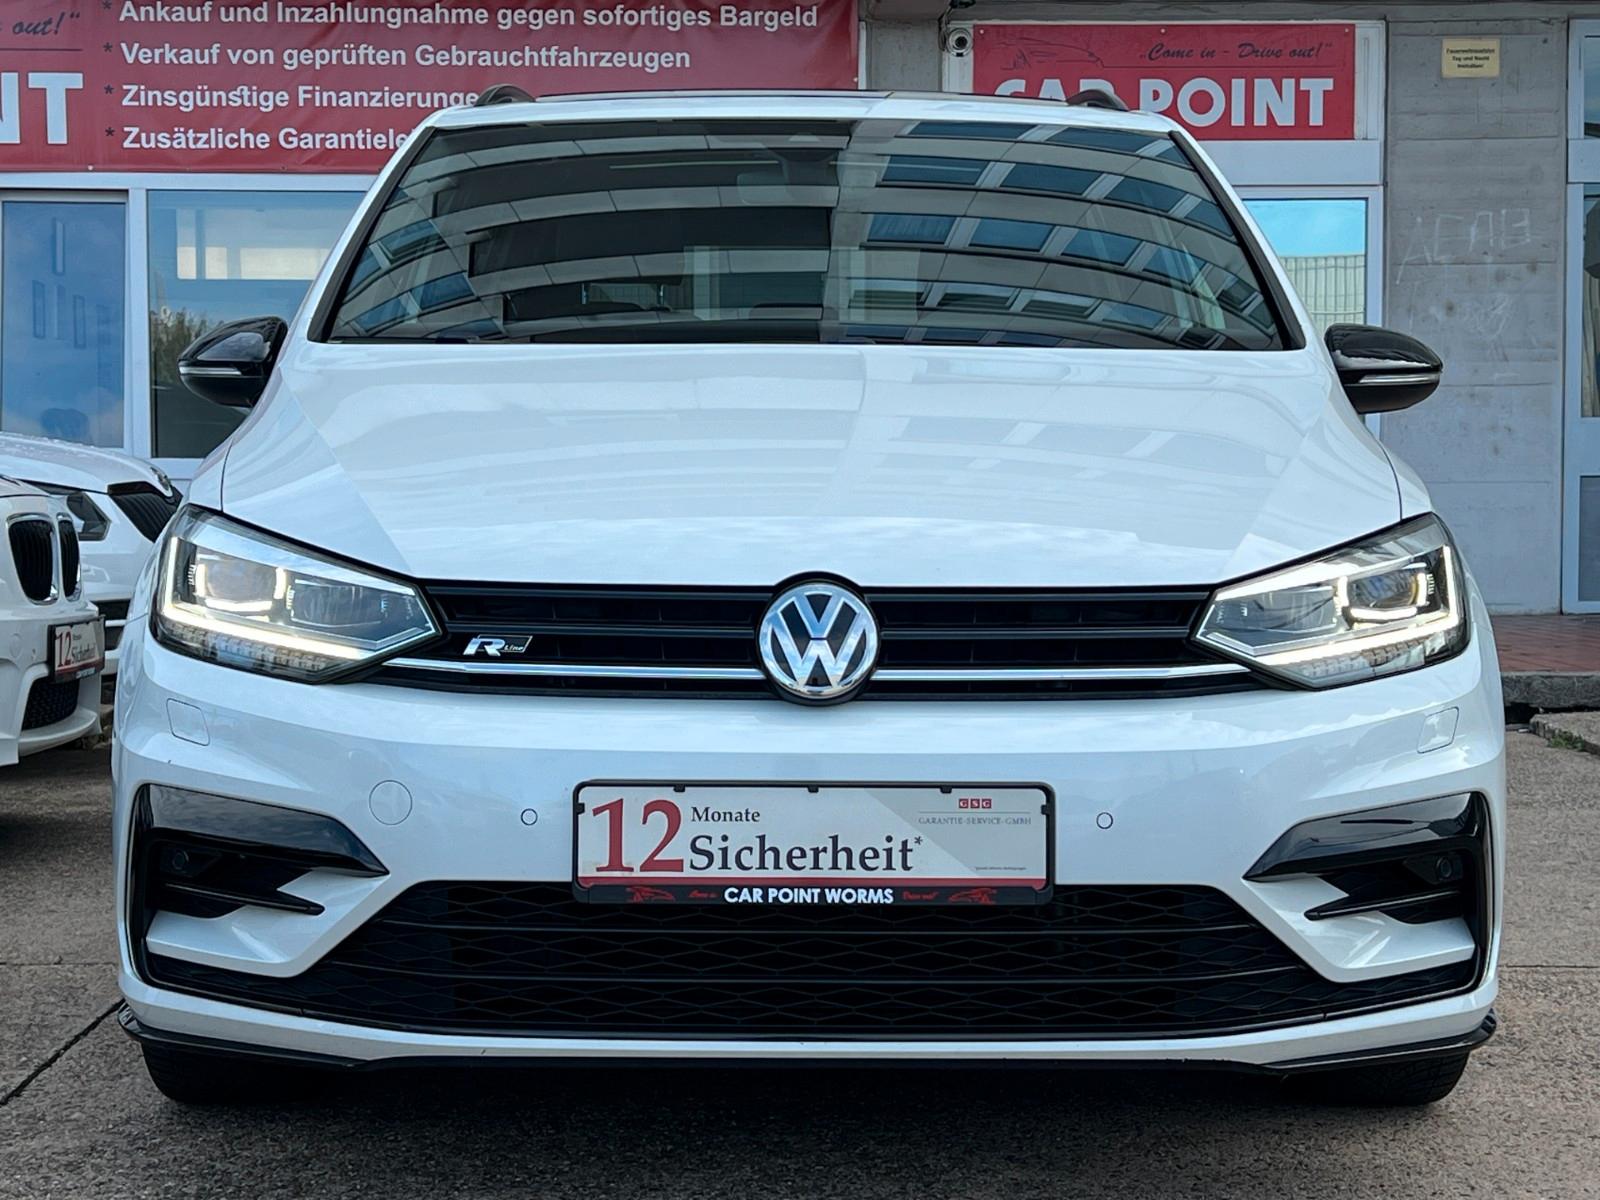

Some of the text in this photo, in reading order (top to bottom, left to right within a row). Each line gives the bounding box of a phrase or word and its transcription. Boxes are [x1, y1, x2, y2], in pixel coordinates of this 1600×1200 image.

[119, 1, 817, 32] Ankauf und Inzahlungnahme gegen sofortiges Bargeld
[120, 43, 691, 73] Verkauf von geprüften Gebrauchtfahrzeugen
[1200, 47, 1216, 58] in
[1238, 43, 1283, 58] Drive
[122, 85, 479, 112] Zinsgünstige Finanzierunge
[1140, 77, 1334, 127] POINT
[123, 127, 412, 149] Zusätzliche Garantiele
[959, 799, 992, 808] GSG
[592, 798, 761, 872] 12 Monate
[724, 887, 763, 903] CAR
[768, 887, 821, 903] POINT
[824, 887, 894, 904] WORMS
